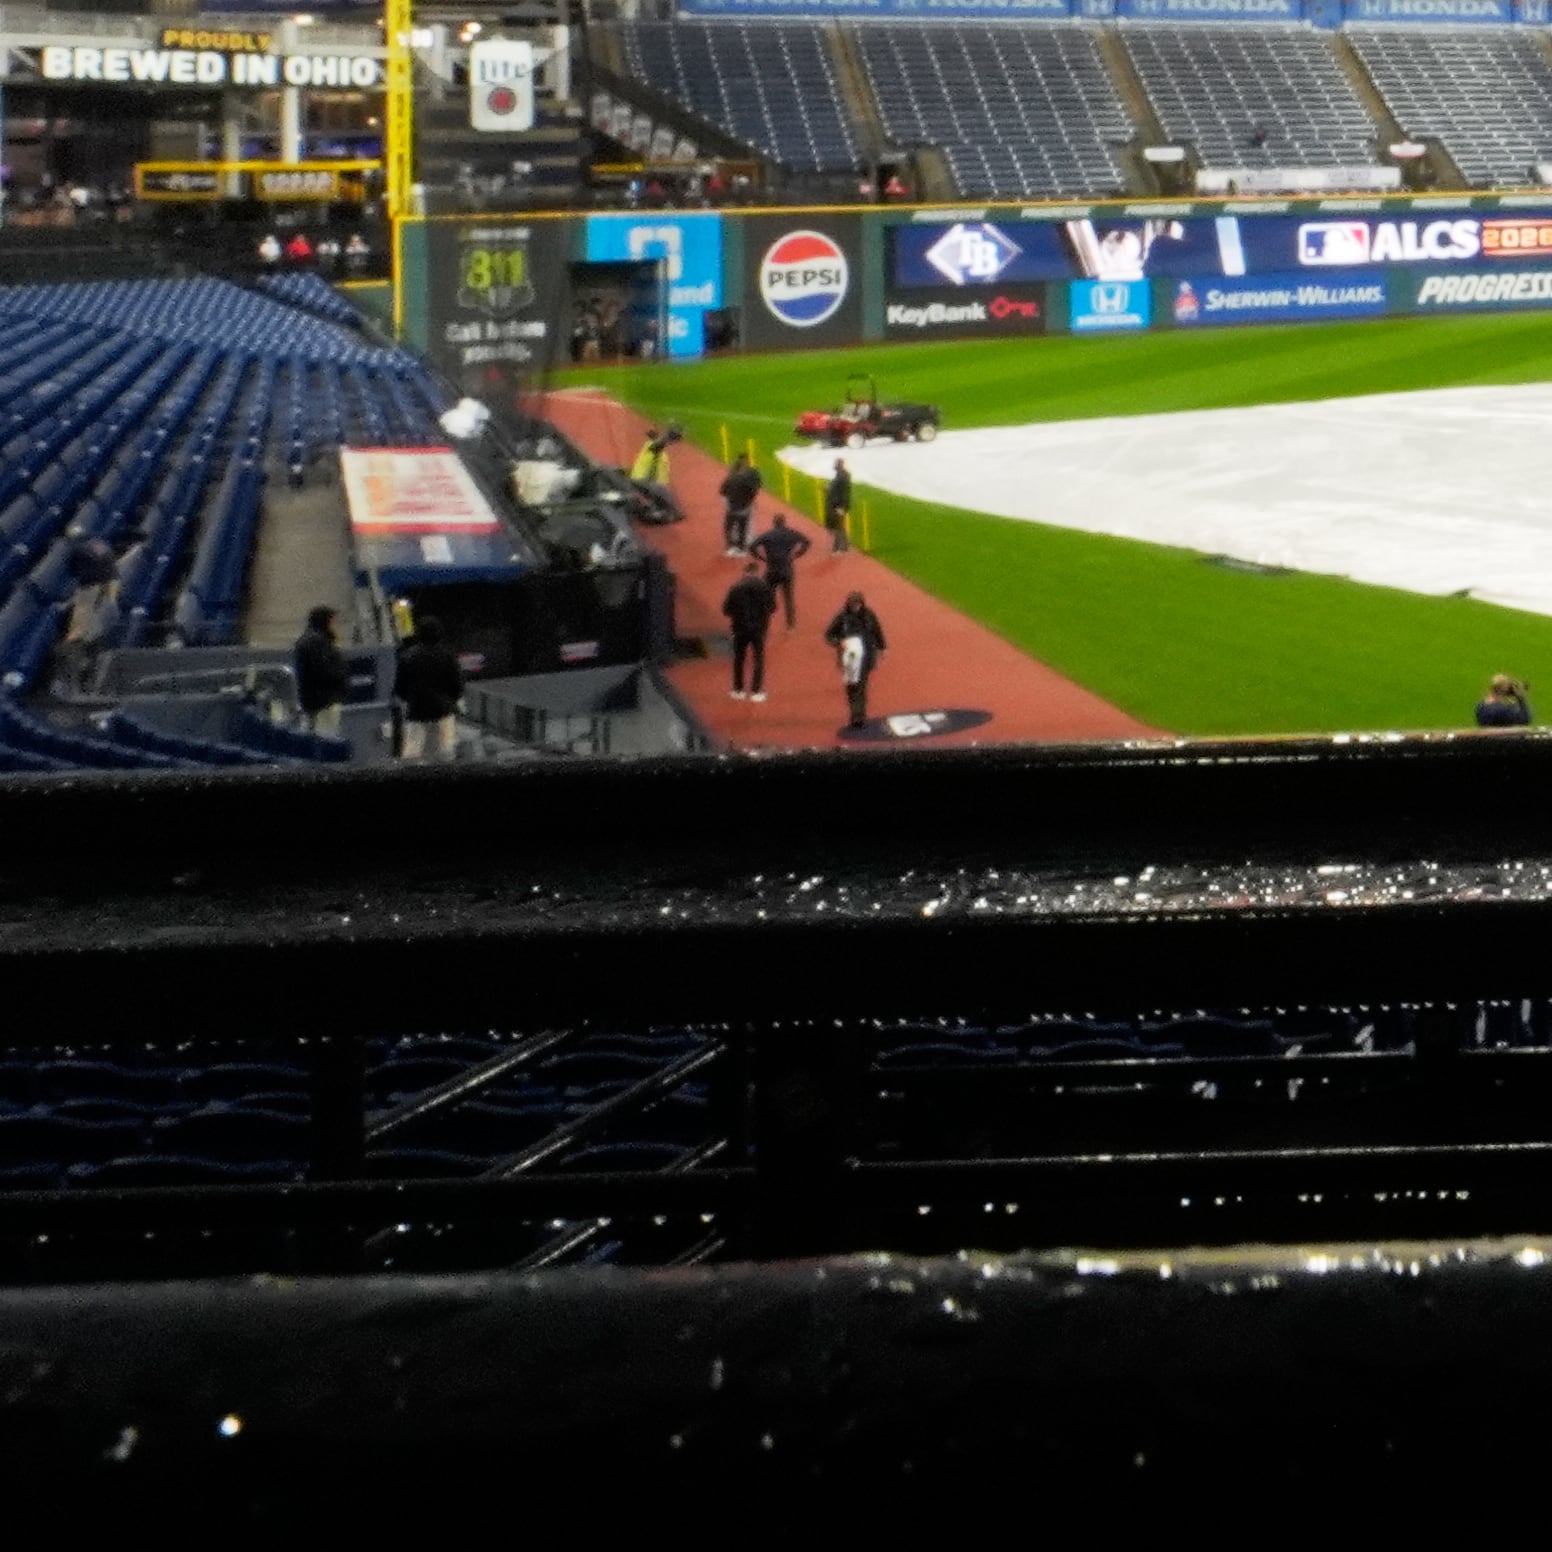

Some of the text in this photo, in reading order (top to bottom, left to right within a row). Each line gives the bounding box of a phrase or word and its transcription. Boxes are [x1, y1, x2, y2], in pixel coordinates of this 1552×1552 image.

[1389, 0, 1499, 16] HONDA
[163, 29, 273, 51] PROUDLY
[43, 47, 378, 87] BREWED IN OHIO
[1371, 219, 1481, 262] ALCS
[466, 249, 525, 288] 811
[767, 267, 842, 289] PEPSI
[886, 302, 987, 327] KeyBank
